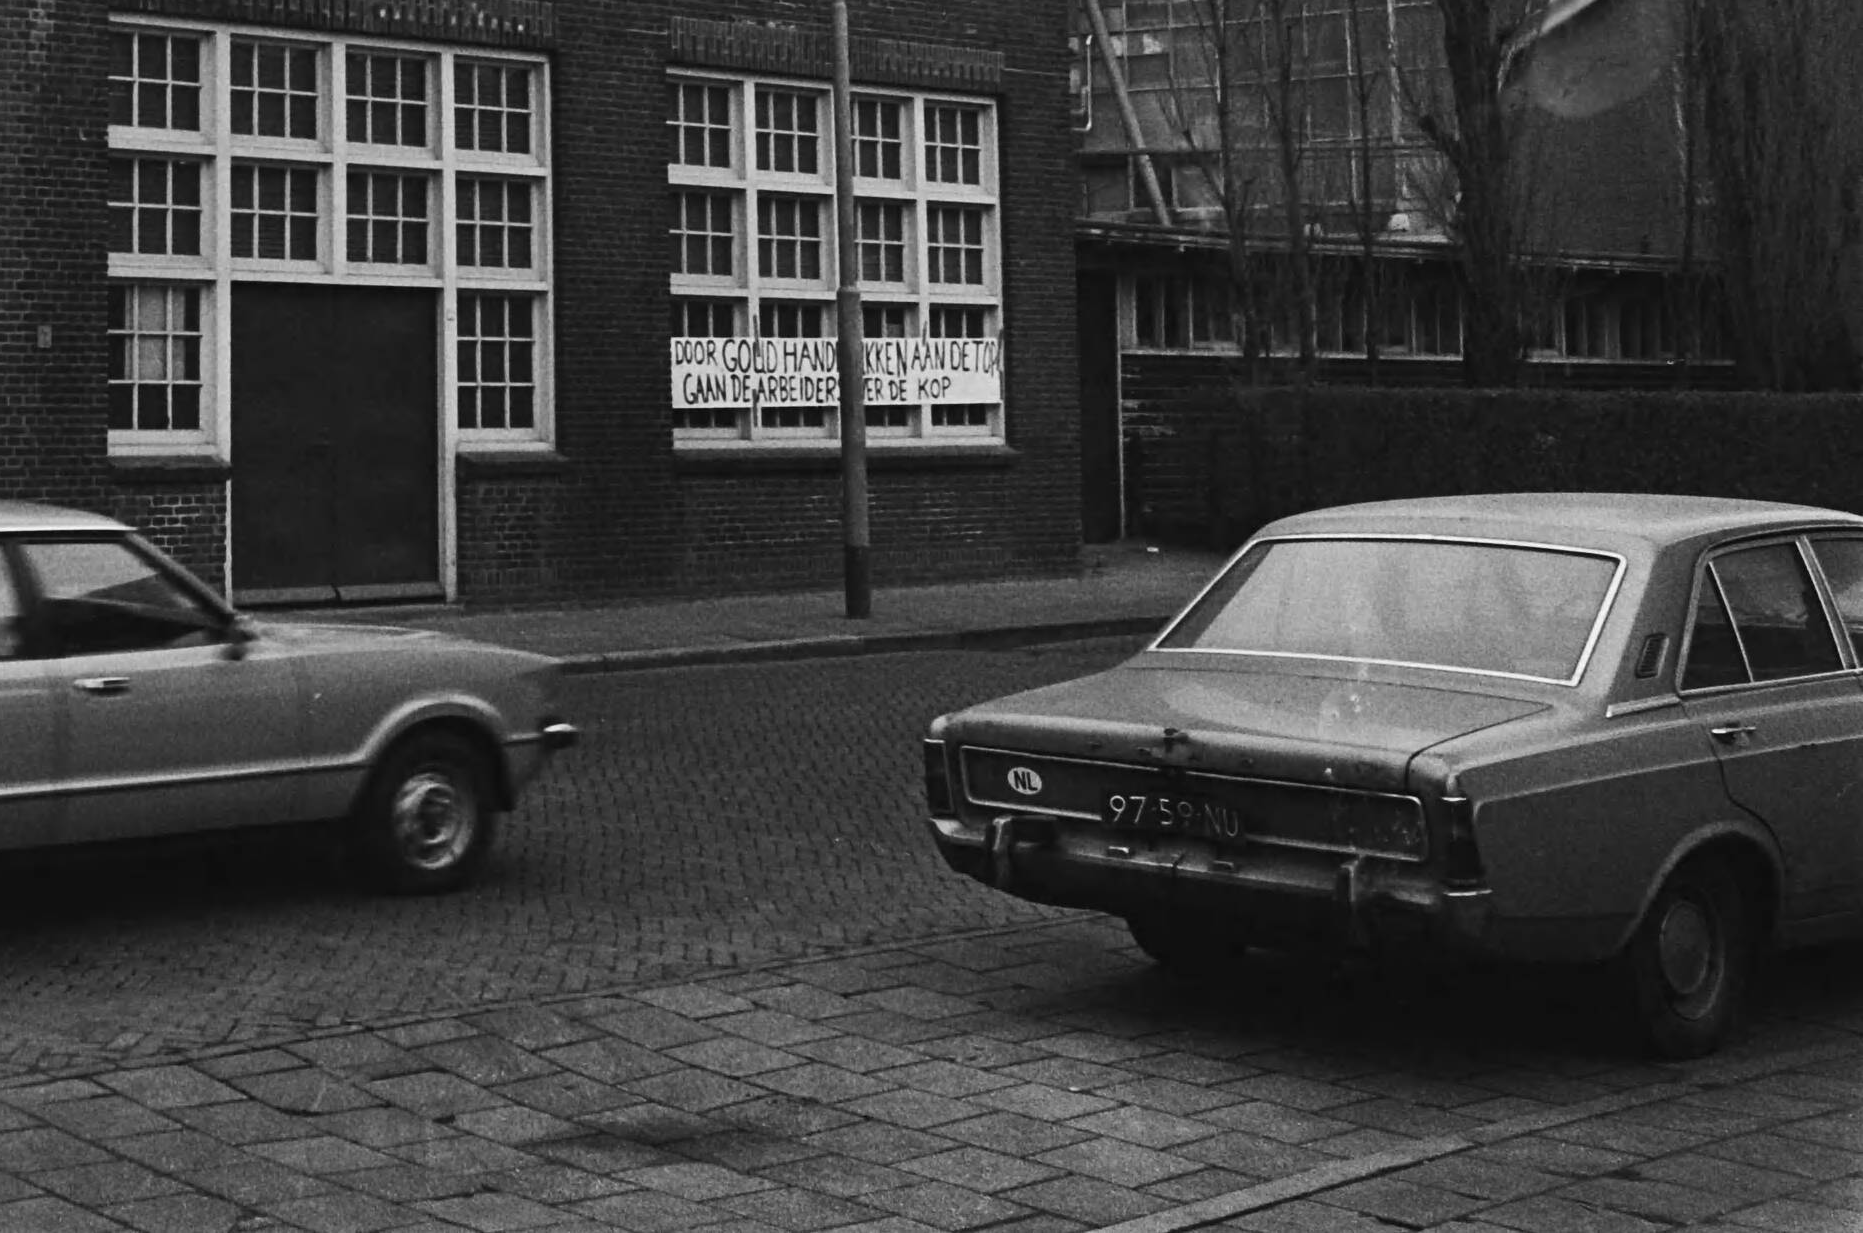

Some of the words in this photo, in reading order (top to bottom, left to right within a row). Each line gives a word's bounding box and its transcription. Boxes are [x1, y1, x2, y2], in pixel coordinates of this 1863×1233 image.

[675, 340, 718, 366] DOOR
[911, 340, 945, 372] AAN
[683, 373, 727, 404] GAAN
[730, 374, 751, 403] DE
[756, 375, 839, 404] ARBEIDER
[888, 379, 907, 402] DE
[918, 376, 952, 399] KOP
[1014, 769, 1038, 791] NL
